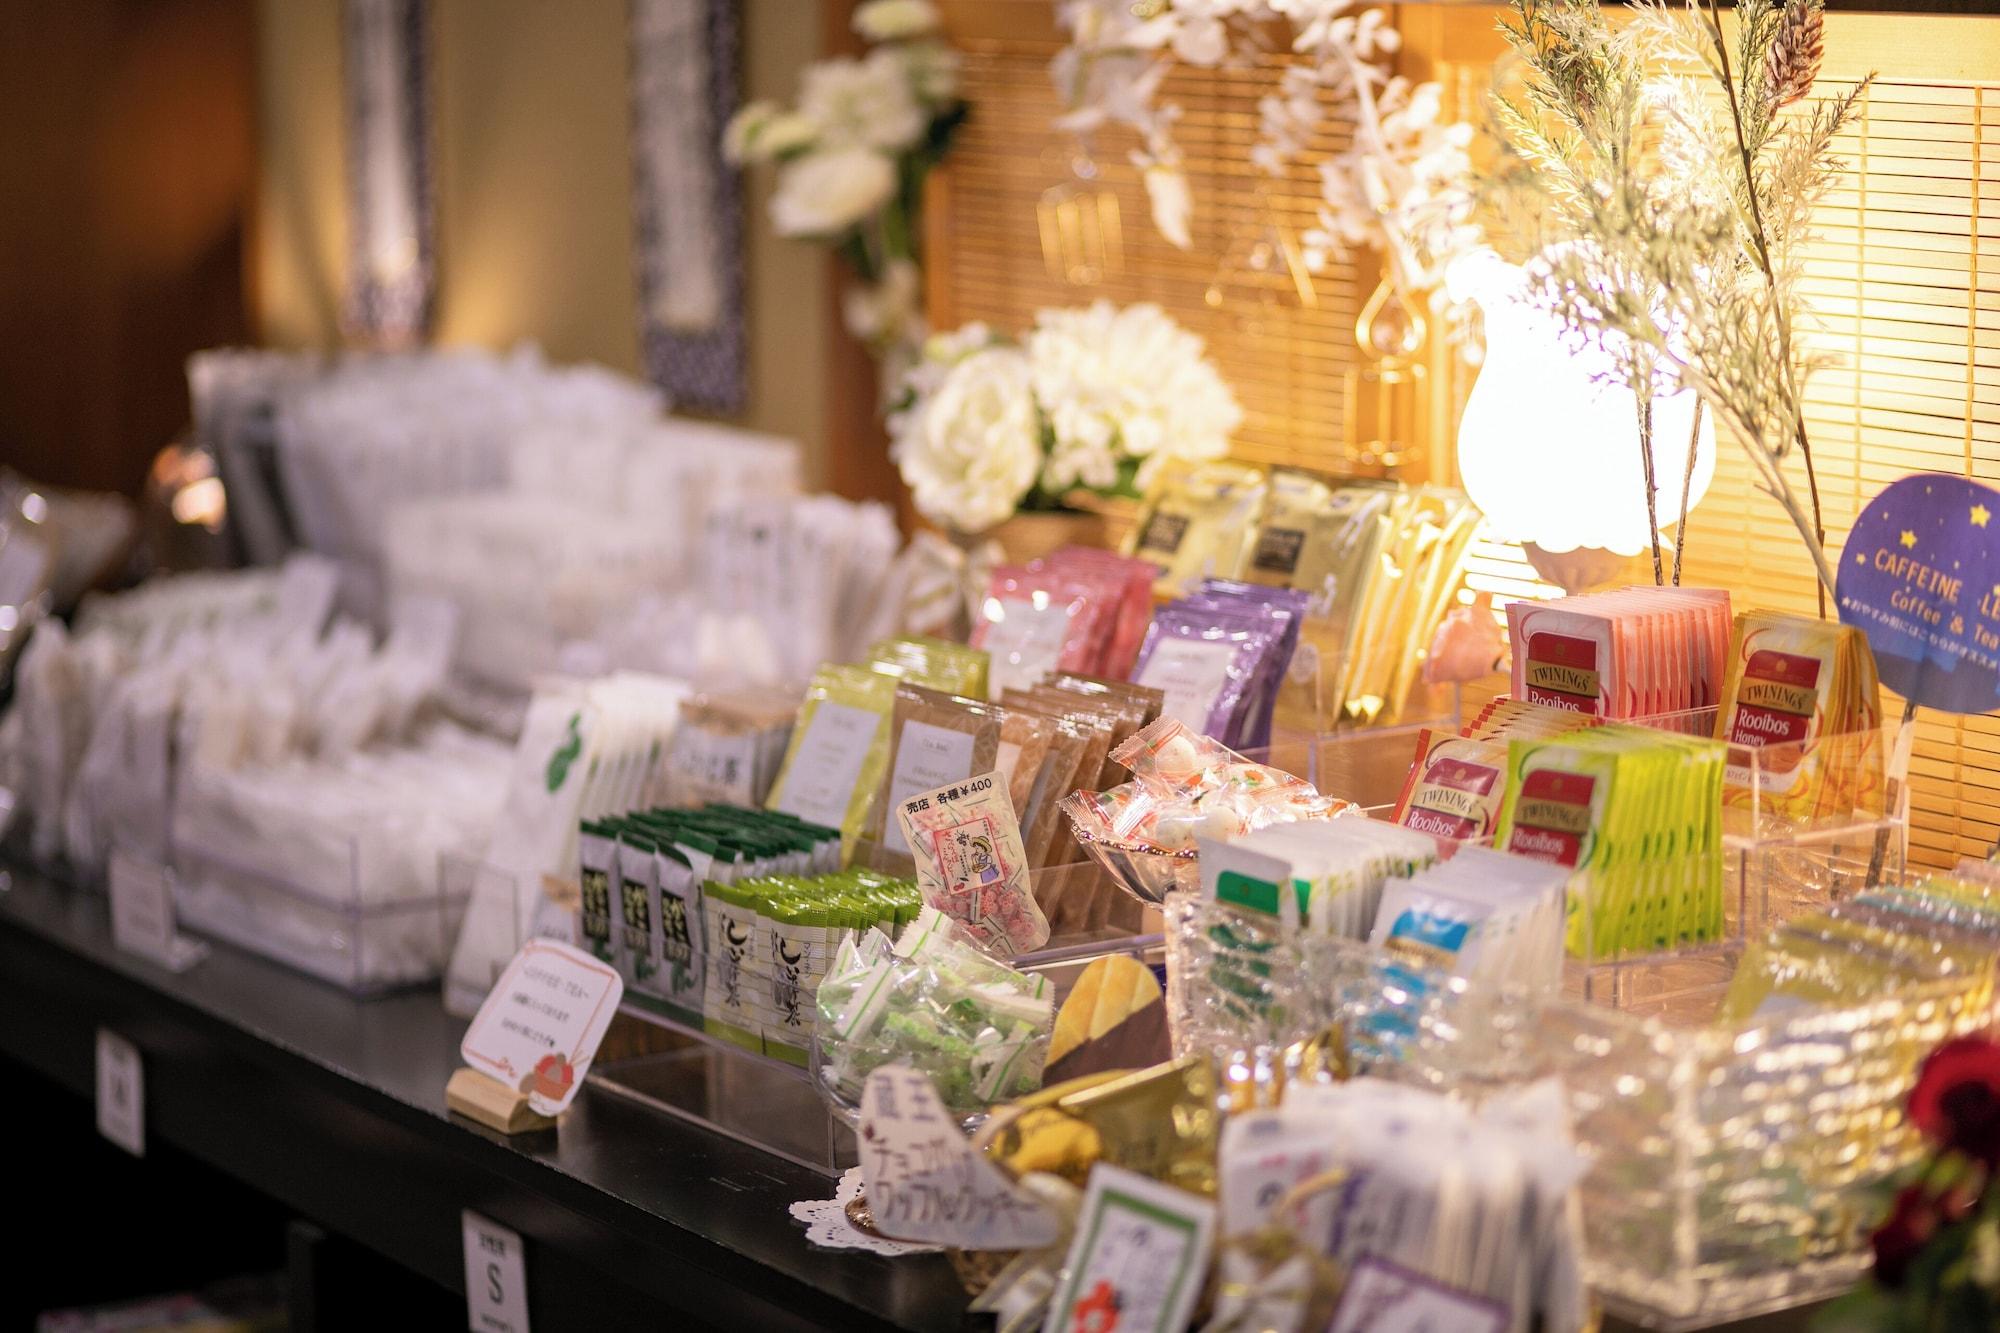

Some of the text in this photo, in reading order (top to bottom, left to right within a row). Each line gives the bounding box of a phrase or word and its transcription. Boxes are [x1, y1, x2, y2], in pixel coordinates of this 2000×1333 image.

[1874, 547, 1963, 606] CAFFEINE
[1890, 589, 2000, 652] Coffee & Tea
[1532, 666, 1590, 692] TWININGS
[1531, 691, 1580, 712] Rooibos
[1746, 684, 1804, 711] TWININGS
[1738, 708, 1791, 737] Rooibos
[1734, 729, 1767, 750] Honey
[906, 798, 931, 815] 売店
[1421, 788, 1476, 816] TWININGS
[1409, 811, 1457, 838] Rooibos
[1512, 828, 1565, 854] Rooibos
[486, 1262, 504, 1305] S
